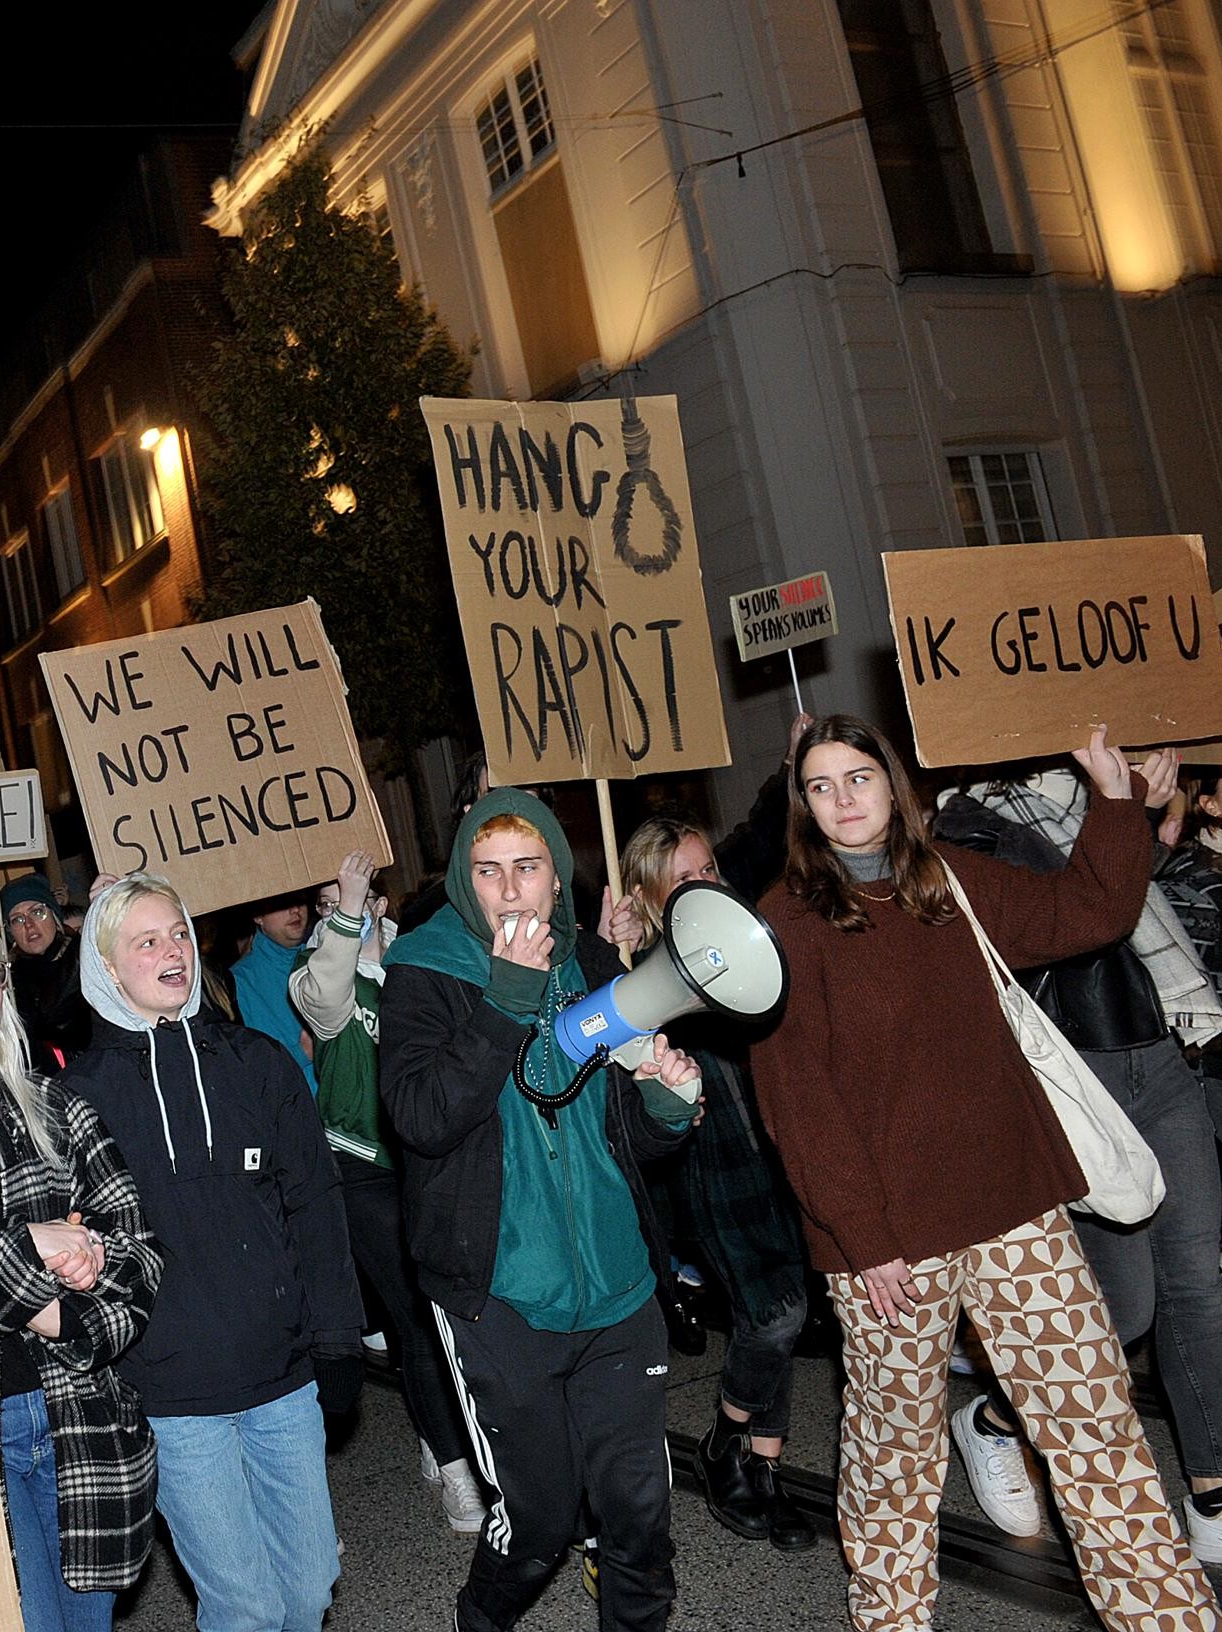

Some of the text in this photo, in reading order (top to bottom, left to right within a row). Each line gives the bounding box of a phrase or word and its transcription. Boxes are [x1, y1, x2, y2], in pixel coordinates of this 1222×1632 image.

[444, 421, 611, 519] HANG
[469, 530, 608, 611] YOUR
[739, 588, 781, 621] YOUR
[64, 624, 320, 724] WE WILL
[743, 613, 791, 646] SPEAKS
[906, 594, 1200, 686] IK GELOOF U
[491, 619, 684, 762] RAPIST
[98, 704, 295, 796] NOT BE
[113, 766, 357, 876] SILENCED
